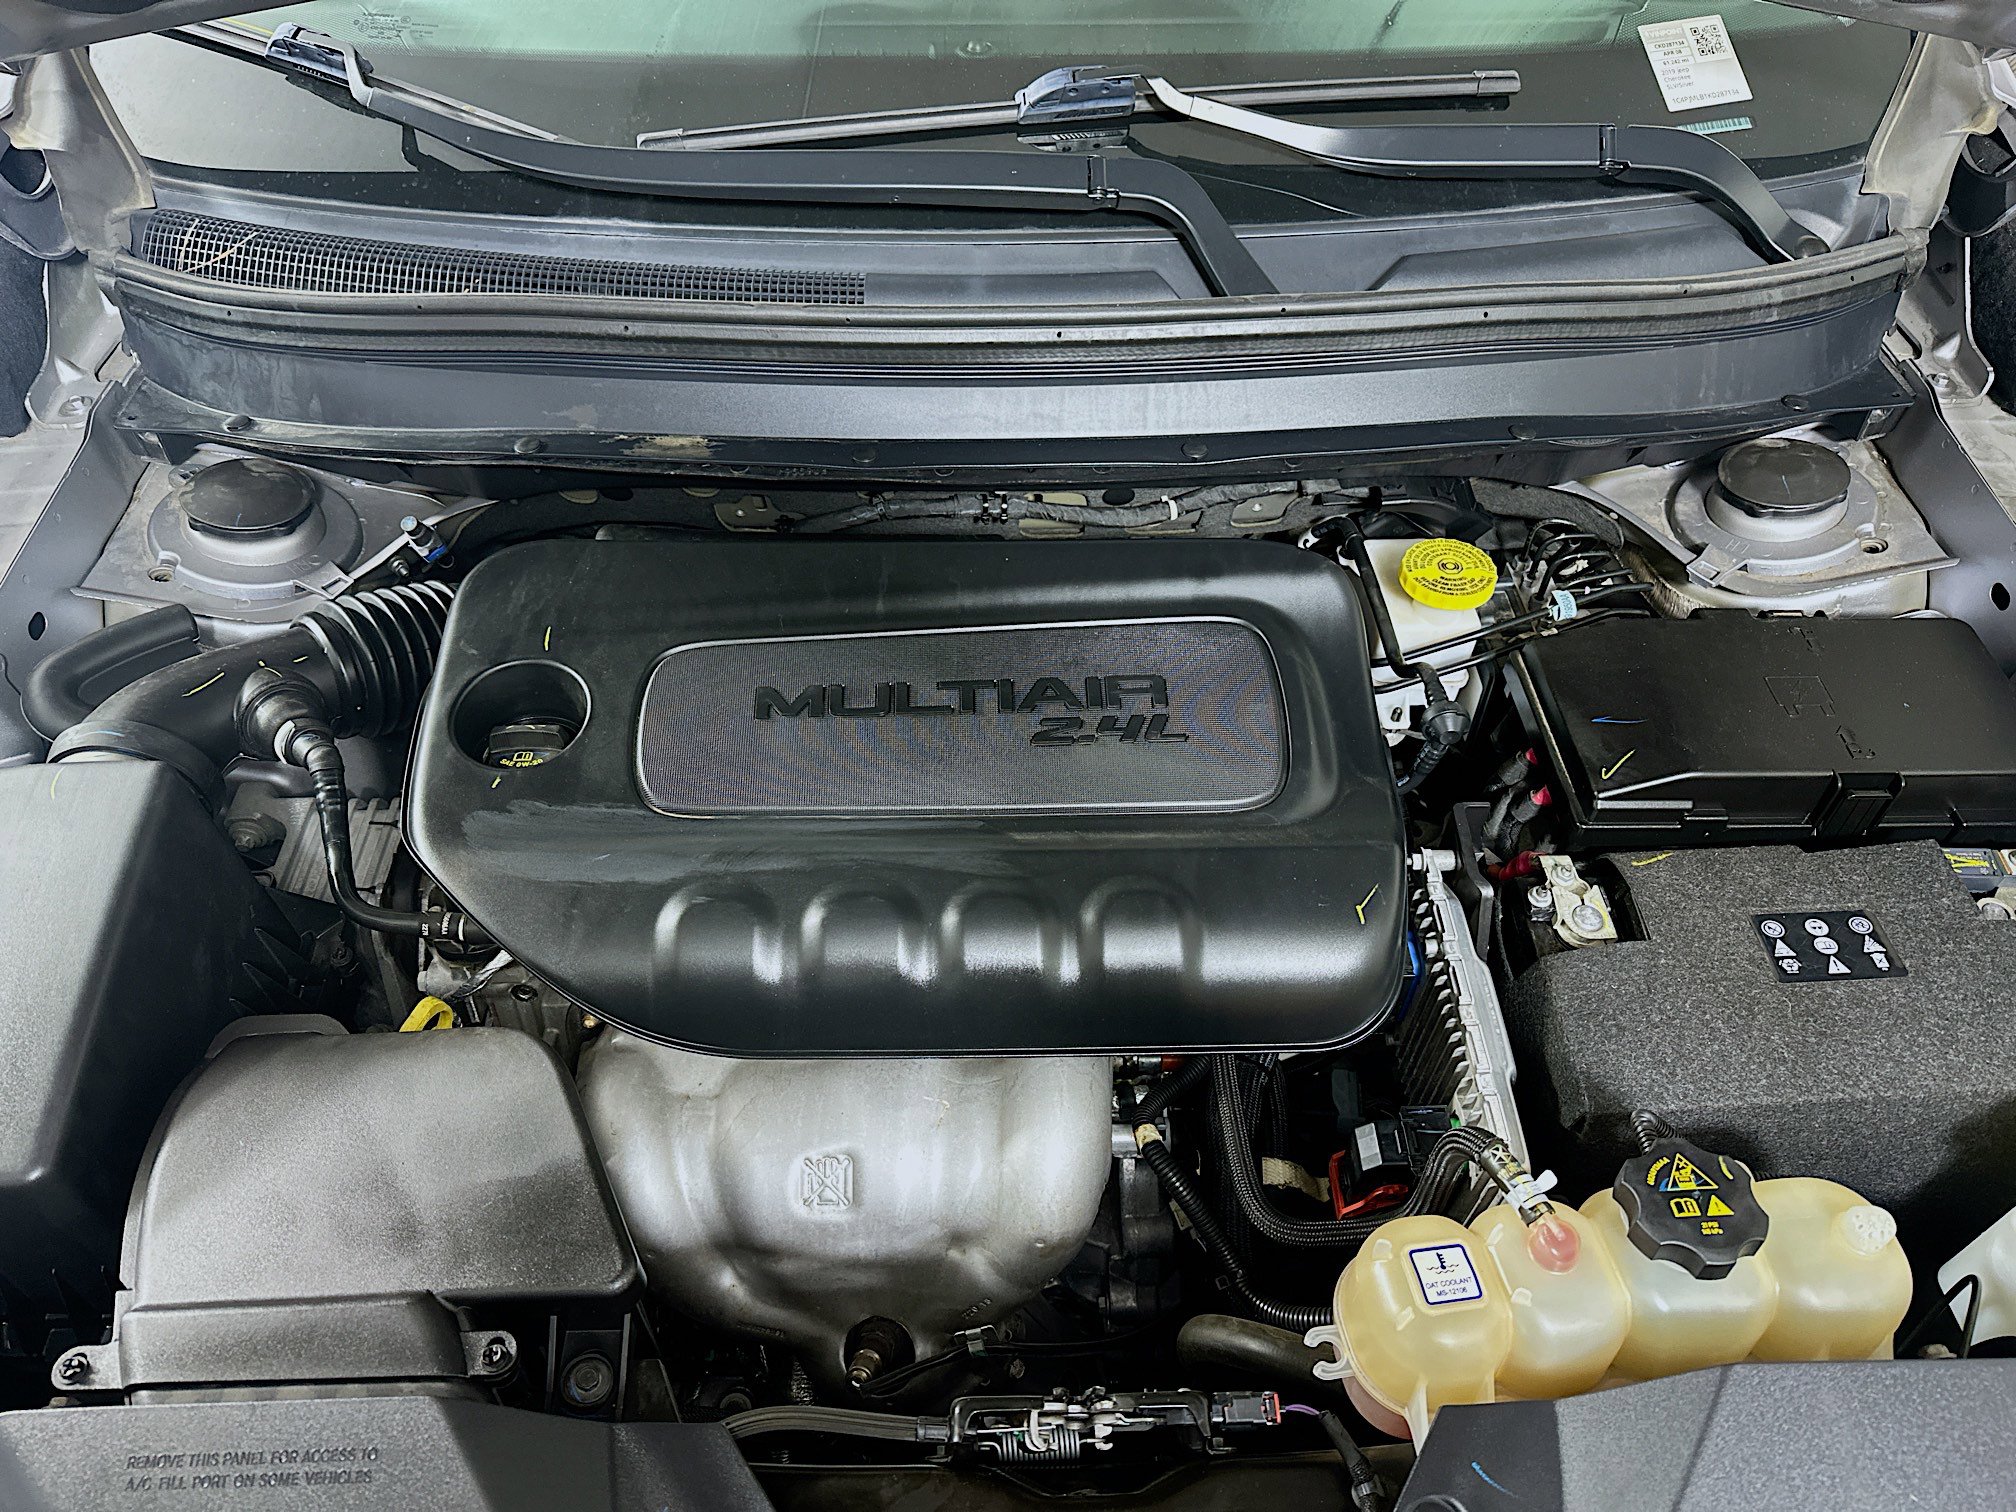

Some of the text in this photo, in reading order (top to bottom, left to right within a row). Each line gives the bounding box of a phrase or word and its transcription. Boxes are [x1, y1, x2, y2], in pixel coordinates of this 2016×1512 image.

[1662, 68, 1676, 76] 2019
[755, 674, 1169, 720] MULTIAIR
[1031, 713, 1189, 746] 2.4L
[500, 759, 515, 767] SAE
[1425, 1276, 1472, 1290] OAT COOLANT
[125, 1446, 378, 1470] REMOVE THIS PANEL FOR ACCESS TO
[125, 1469, 373, 1492] A/C FILL PORT ON SOME VEHICLES
